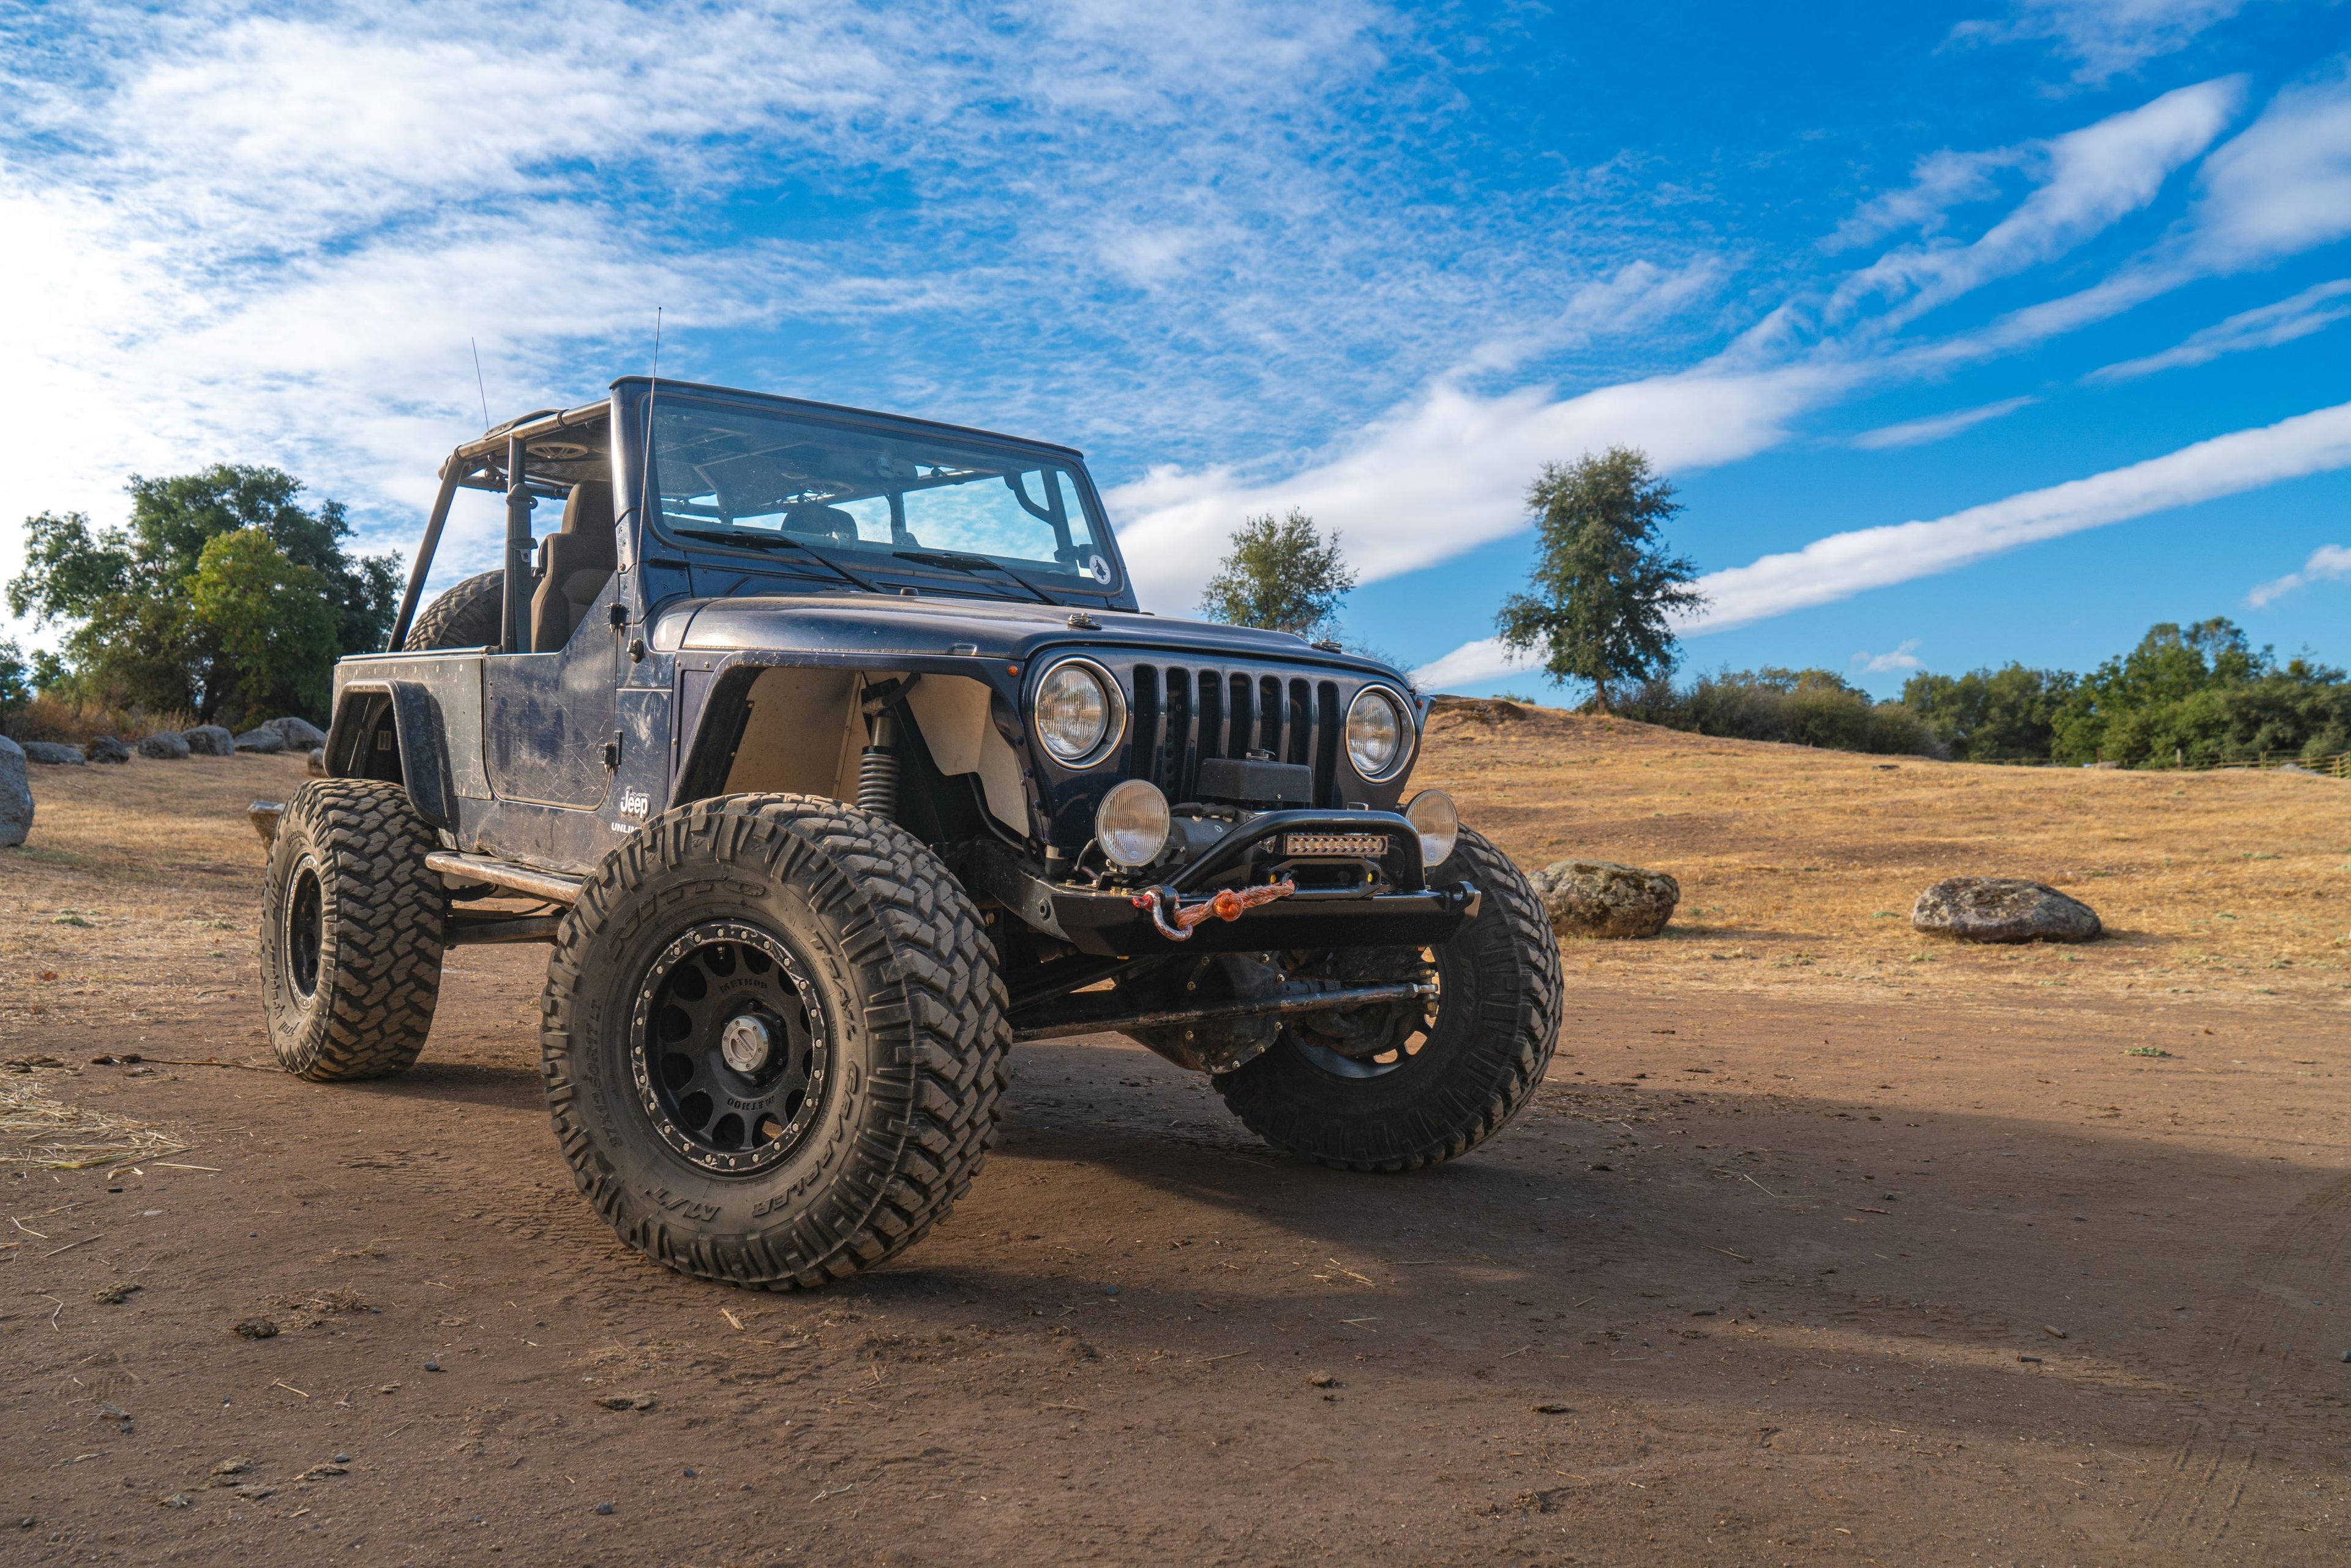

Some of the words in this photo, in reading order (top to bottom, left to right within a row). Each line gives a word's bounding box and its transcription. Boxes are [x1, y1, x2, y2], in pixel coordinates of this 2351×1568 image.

[620, 787, 649, 819] Jeep
[608, 876, 766, 962] NITTO
[720, 978, 768, 994] METHOD
[809, 929, 857, 1041] TRAIL
[736, 1037, 750, 1052] YUKON
[727, 1095, 775, 1111] METHOD
[751, 1059, 858, 1218] GRAPPLER
[643, 1187, 722, 1223] M/T
